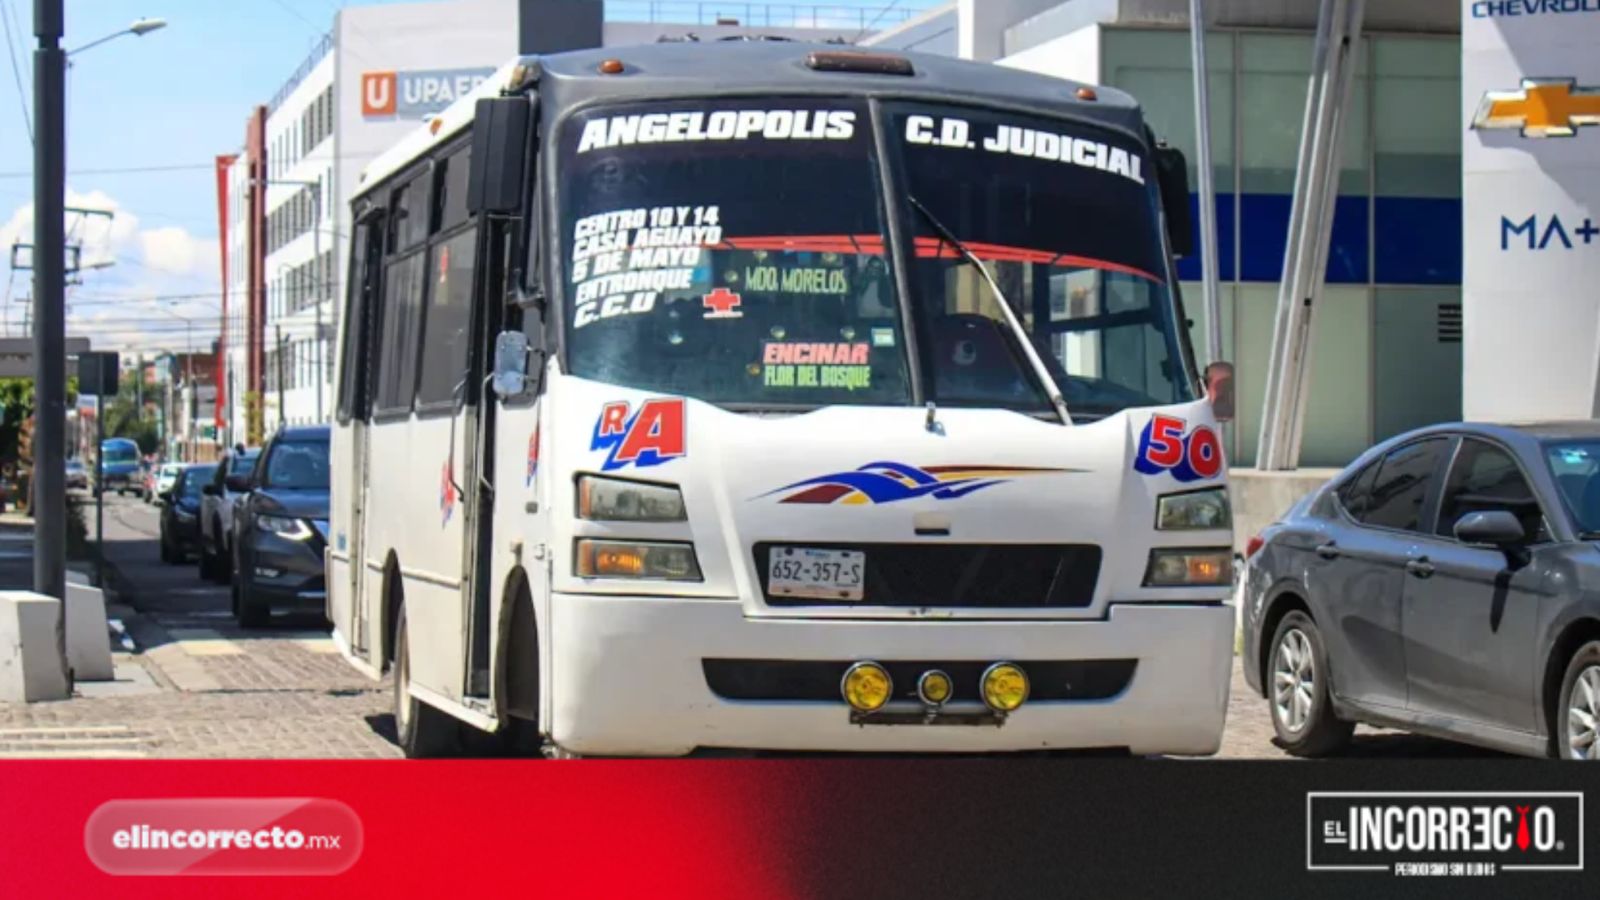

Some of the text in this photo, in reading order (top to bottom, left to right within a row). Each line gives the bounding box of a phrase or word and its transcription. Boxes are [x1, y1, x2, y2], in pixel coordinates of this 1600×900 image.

[1472, 0, 1600, 18] CHEVROL
[577, 110, 856, 153] ANGELOPOLIS
[905, 115, 1145, 185] C.D. JUDICIAL
[574, 205, 720, 241] CENTRO 10 Y 14
[573, 226, 722, 261] CASA AGUAYO
[593, 251, 624, 276] DE
[628, 247, 700, 269] MAYO
[575, 268, 693, 306] ENTRONQUE
[781, 268, 848, 294] MORELOS
[763, 342, 870, 365] ENCINAR
[764, 365, 871, 391] FLOR DEL BOSQUE
[1143, 412, 1222, 479] 50
[772, 560, 861, 584] 652-357-S
